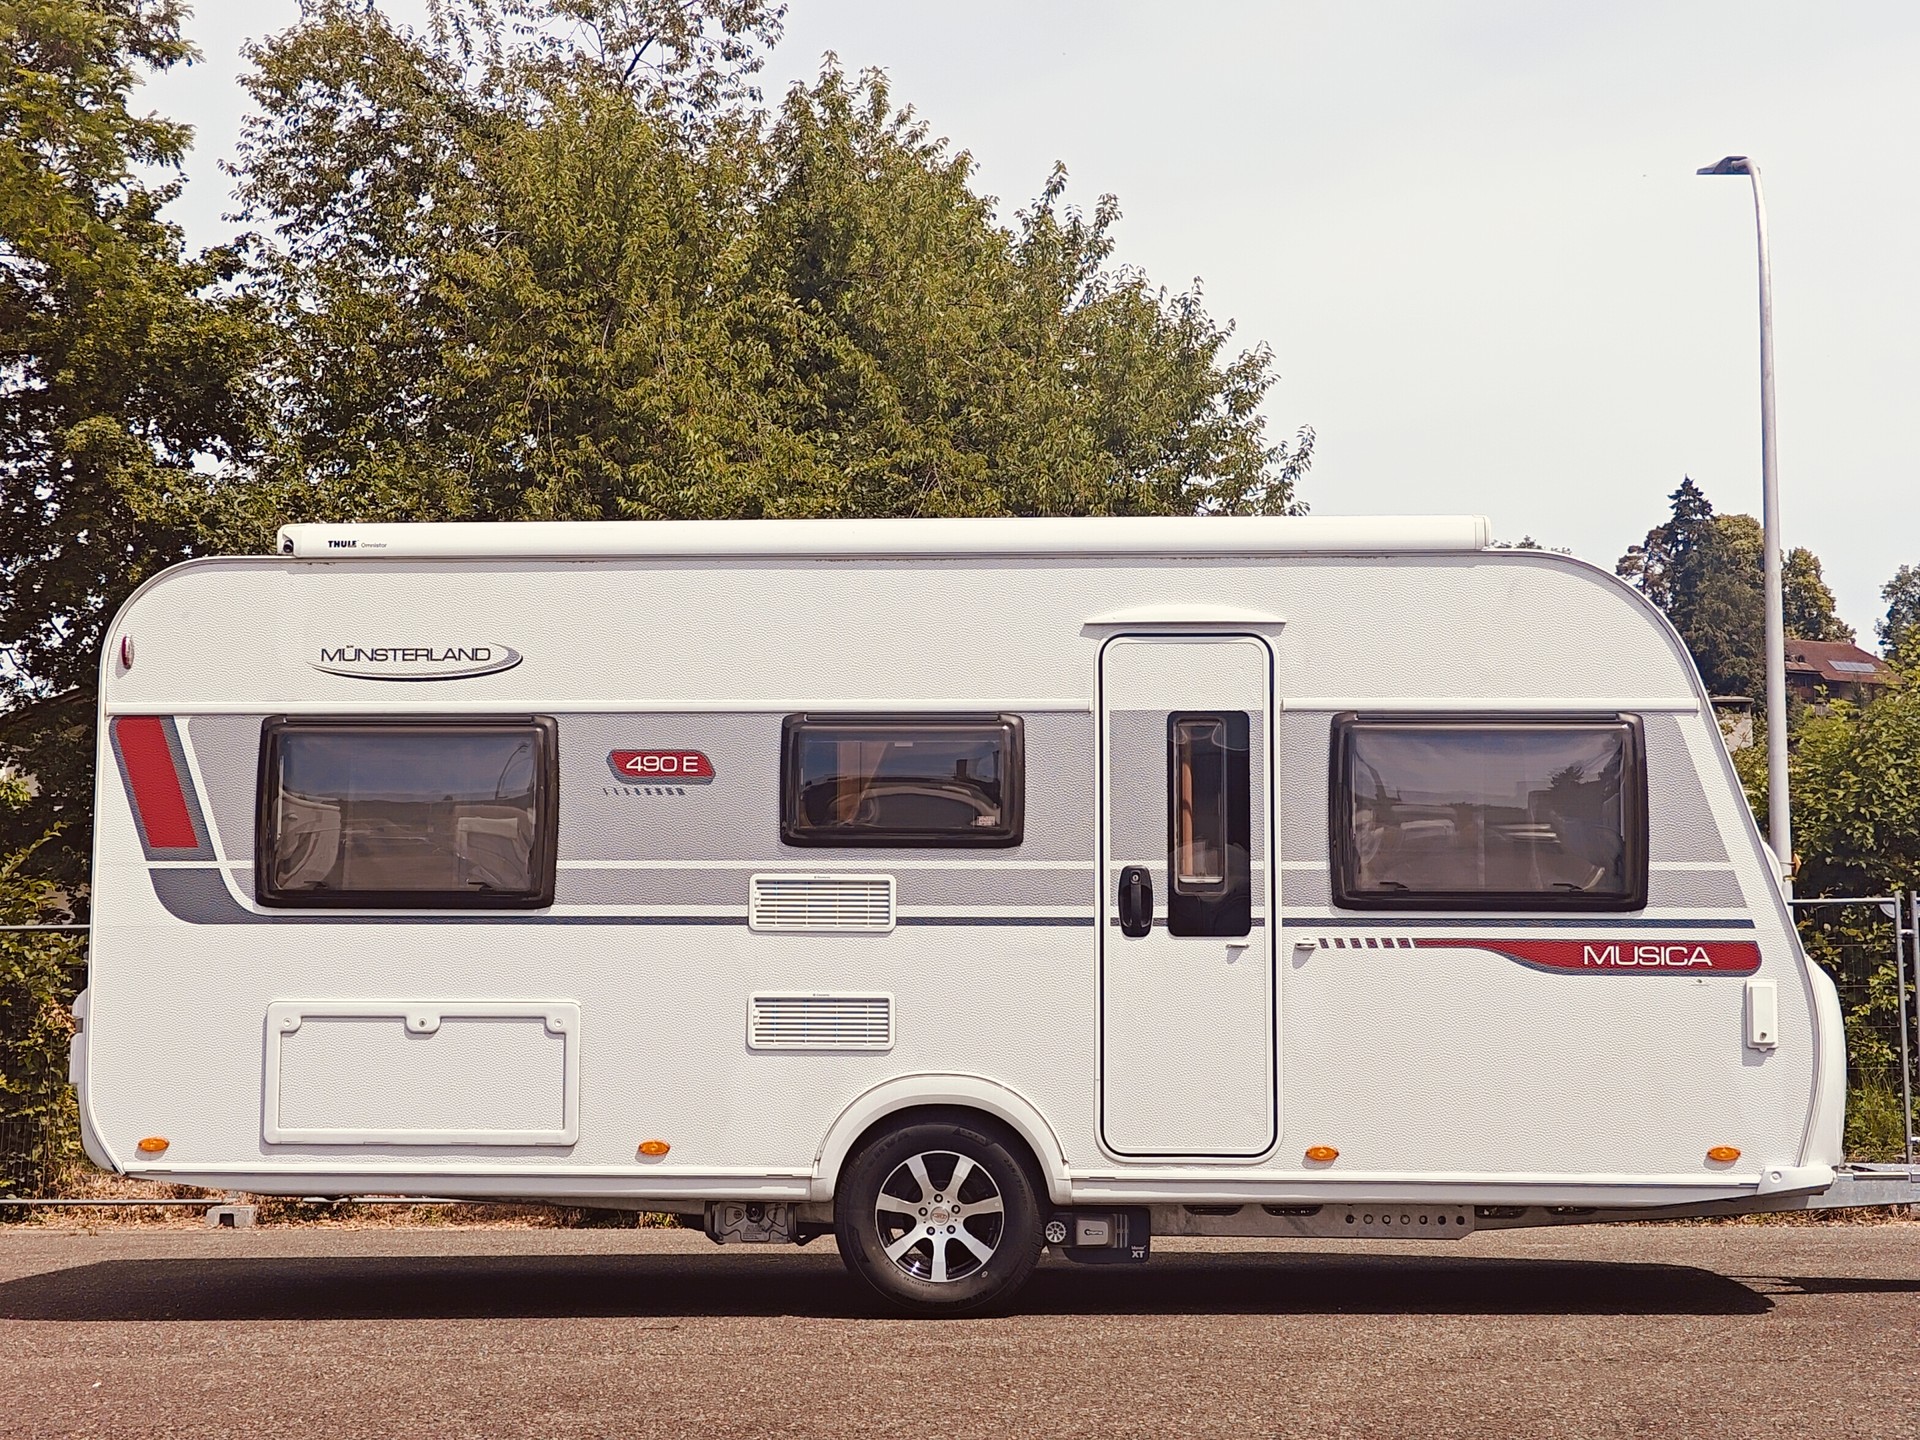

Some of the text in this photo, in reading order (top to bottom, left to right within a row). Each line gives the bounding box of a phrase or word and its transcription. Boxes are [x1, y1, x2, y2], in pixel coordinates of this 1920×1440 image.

[328, 540, 357, 548] THULE
[321, 645, 491, 662] MÜNSTERLAND
[625, 756, 699, 772] 490 E
[1583, 945, 1713, 967] MUSICA
[1131, 1250, 1145, 1258] XT
